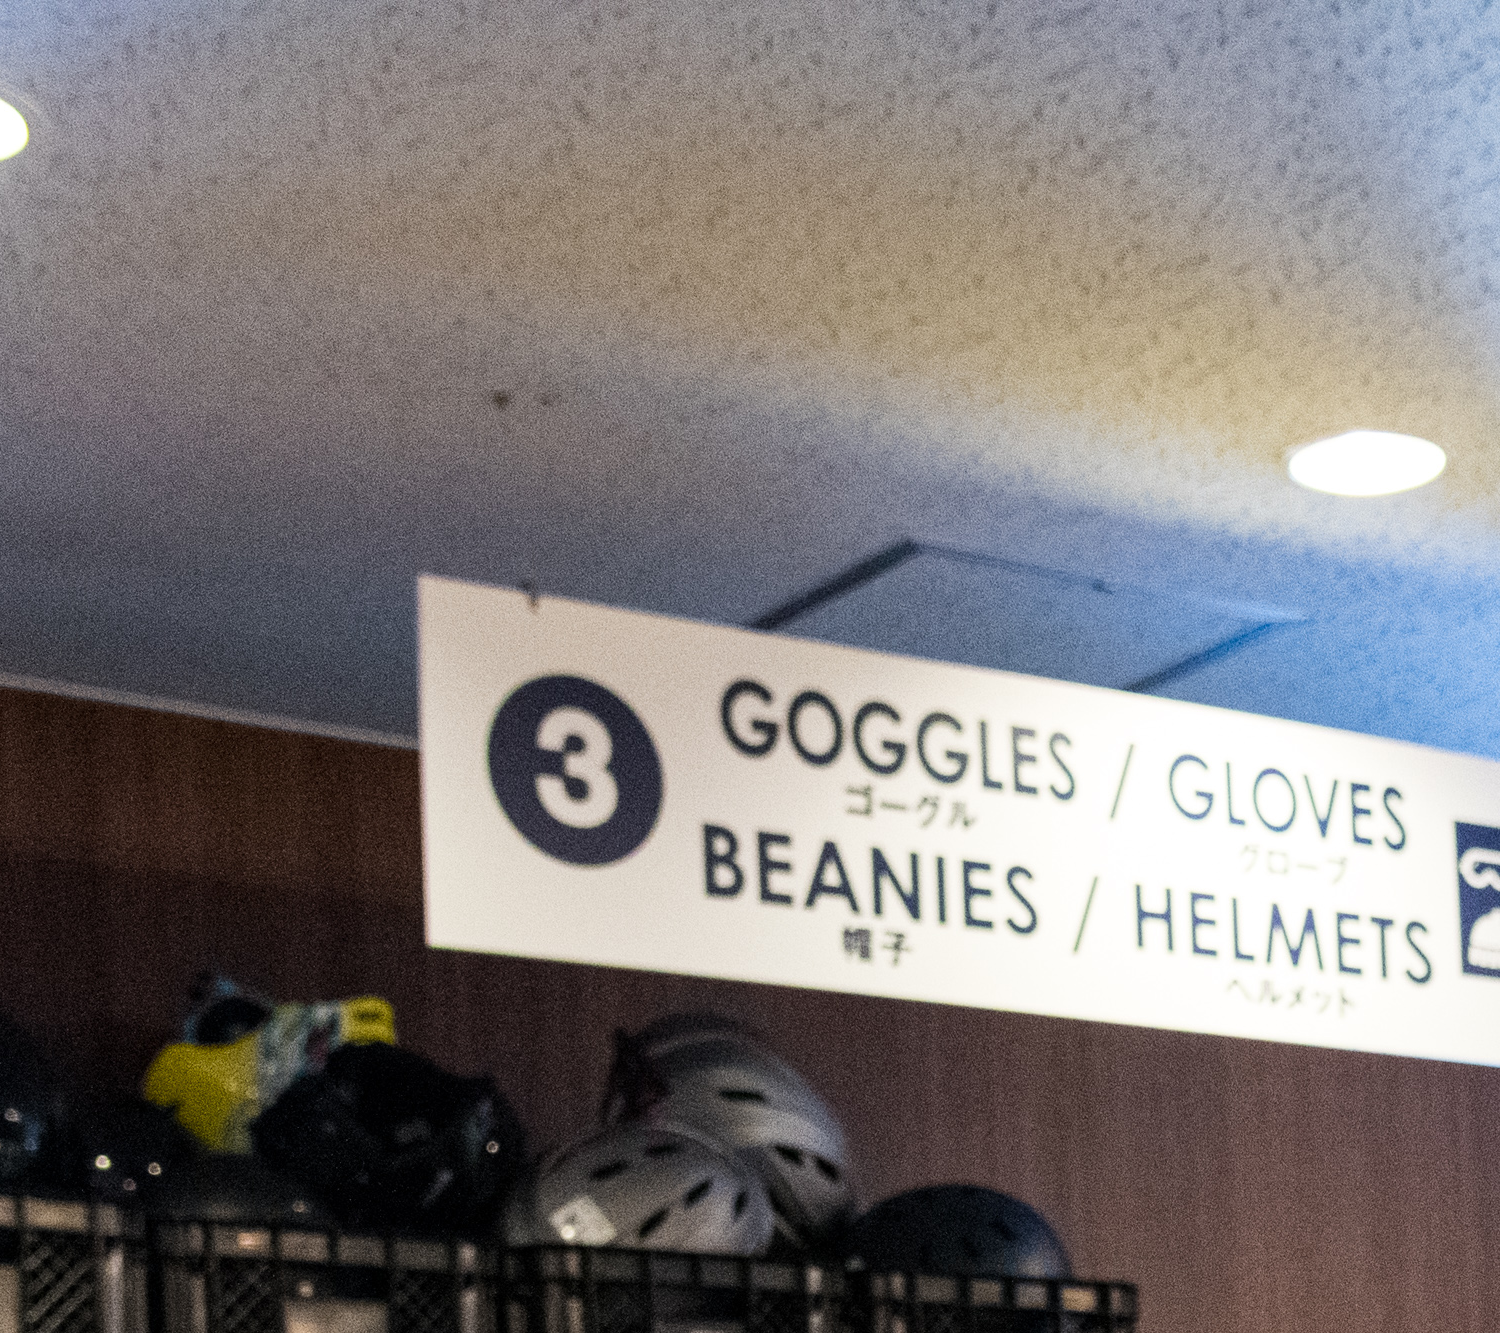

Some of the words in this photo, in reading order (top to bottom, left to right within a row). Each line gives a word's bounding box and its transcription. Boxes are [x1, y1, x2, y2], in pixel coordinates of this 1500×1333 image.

[533, 704, 620, 830] 3
[719, 679, 1077, 801] GOGGLES
[1167, 753, 1409, 853] GLOVES
[845, 783, 977, 831] ゴーグル
[1238, 843, 1350, 885] グローブ
[702, 822, 1038, 936] BEANIES
[1134, 883, 1434, 986] HELMETS
[842, 927, 913, 966] 帽子
[1226, 977, 1356, 1018] ヘルメット
